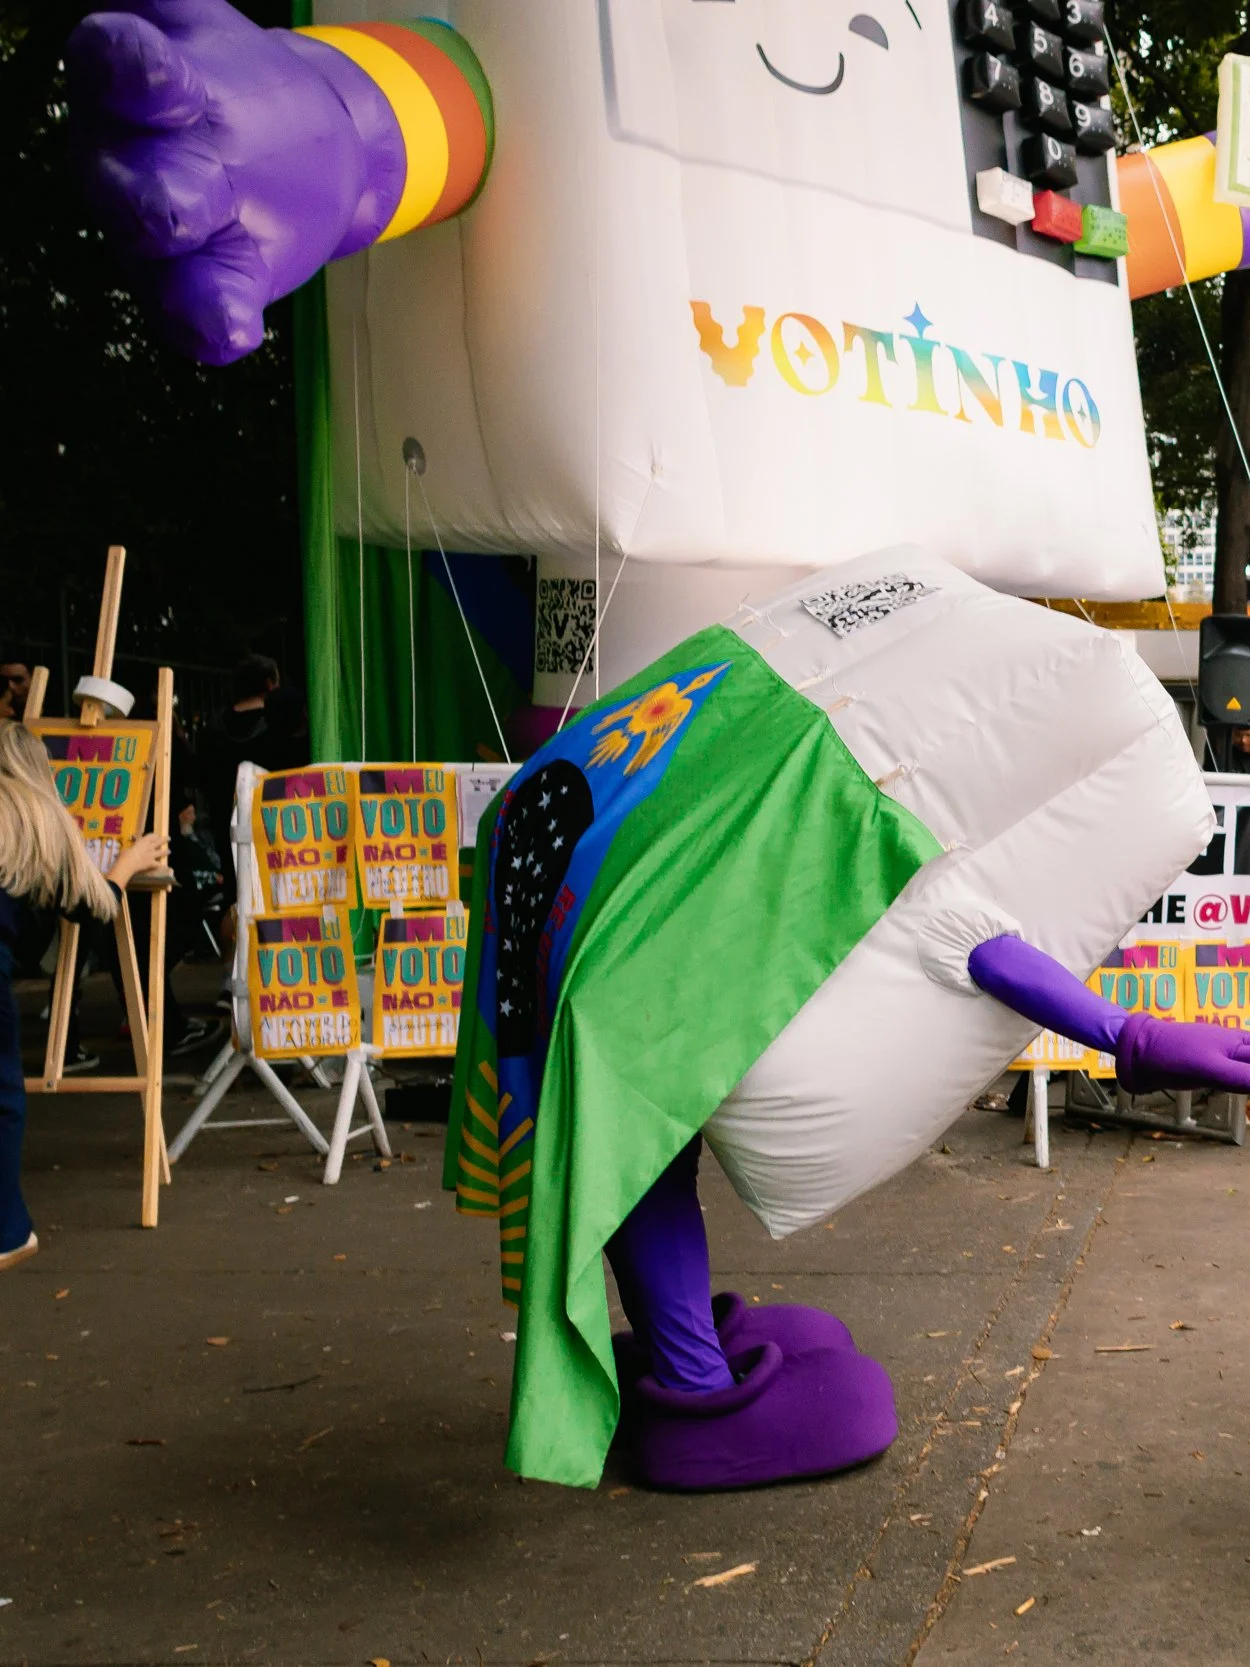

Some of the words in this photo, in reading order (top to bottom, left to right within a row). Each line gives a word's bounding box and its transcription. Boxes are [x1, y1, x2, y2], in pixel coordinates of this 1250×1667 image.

[1066, 0, 1082, 25] 3
[983, 3, 999, 27] 4
[1033, 28, 1048, 53] 5
[1068, 53, 1085, 78] 6
[988, 54, 1002, 80] 7
[1038, 81, 1054, 105] 8
[1074, 104, 1092, 127] 9
[1047, 137, 1061, 160] 0
[689, 300, 1101, 449] VOTINHO
[66, 735, 139, 763] MEU
[52, 766, 131, 809] OTO
[285, 771, 347, 799] MEU
[385, 769, 445, 794] MEU
[261, 801, 349, 845] VOTO
[360, 798, 446, 838] VOTO
[266, 847, 320, 870] NÃO
[363, 841, 416, 862] NÃO
[431, 841, 447, 861] É
[407, 916, 465, 942] MEU
[257, 946, 345, 988] VOTO
[382, 945, 466, 987] VOTO
[1124, 945, 1177, 968] MEU
[259, 990, 314, 1012] NÃO
[331, 988, 349, 1008] É
[382, 990, 434, 1011] NÃO
[1101, 973, 1177, 1011] VOTO
